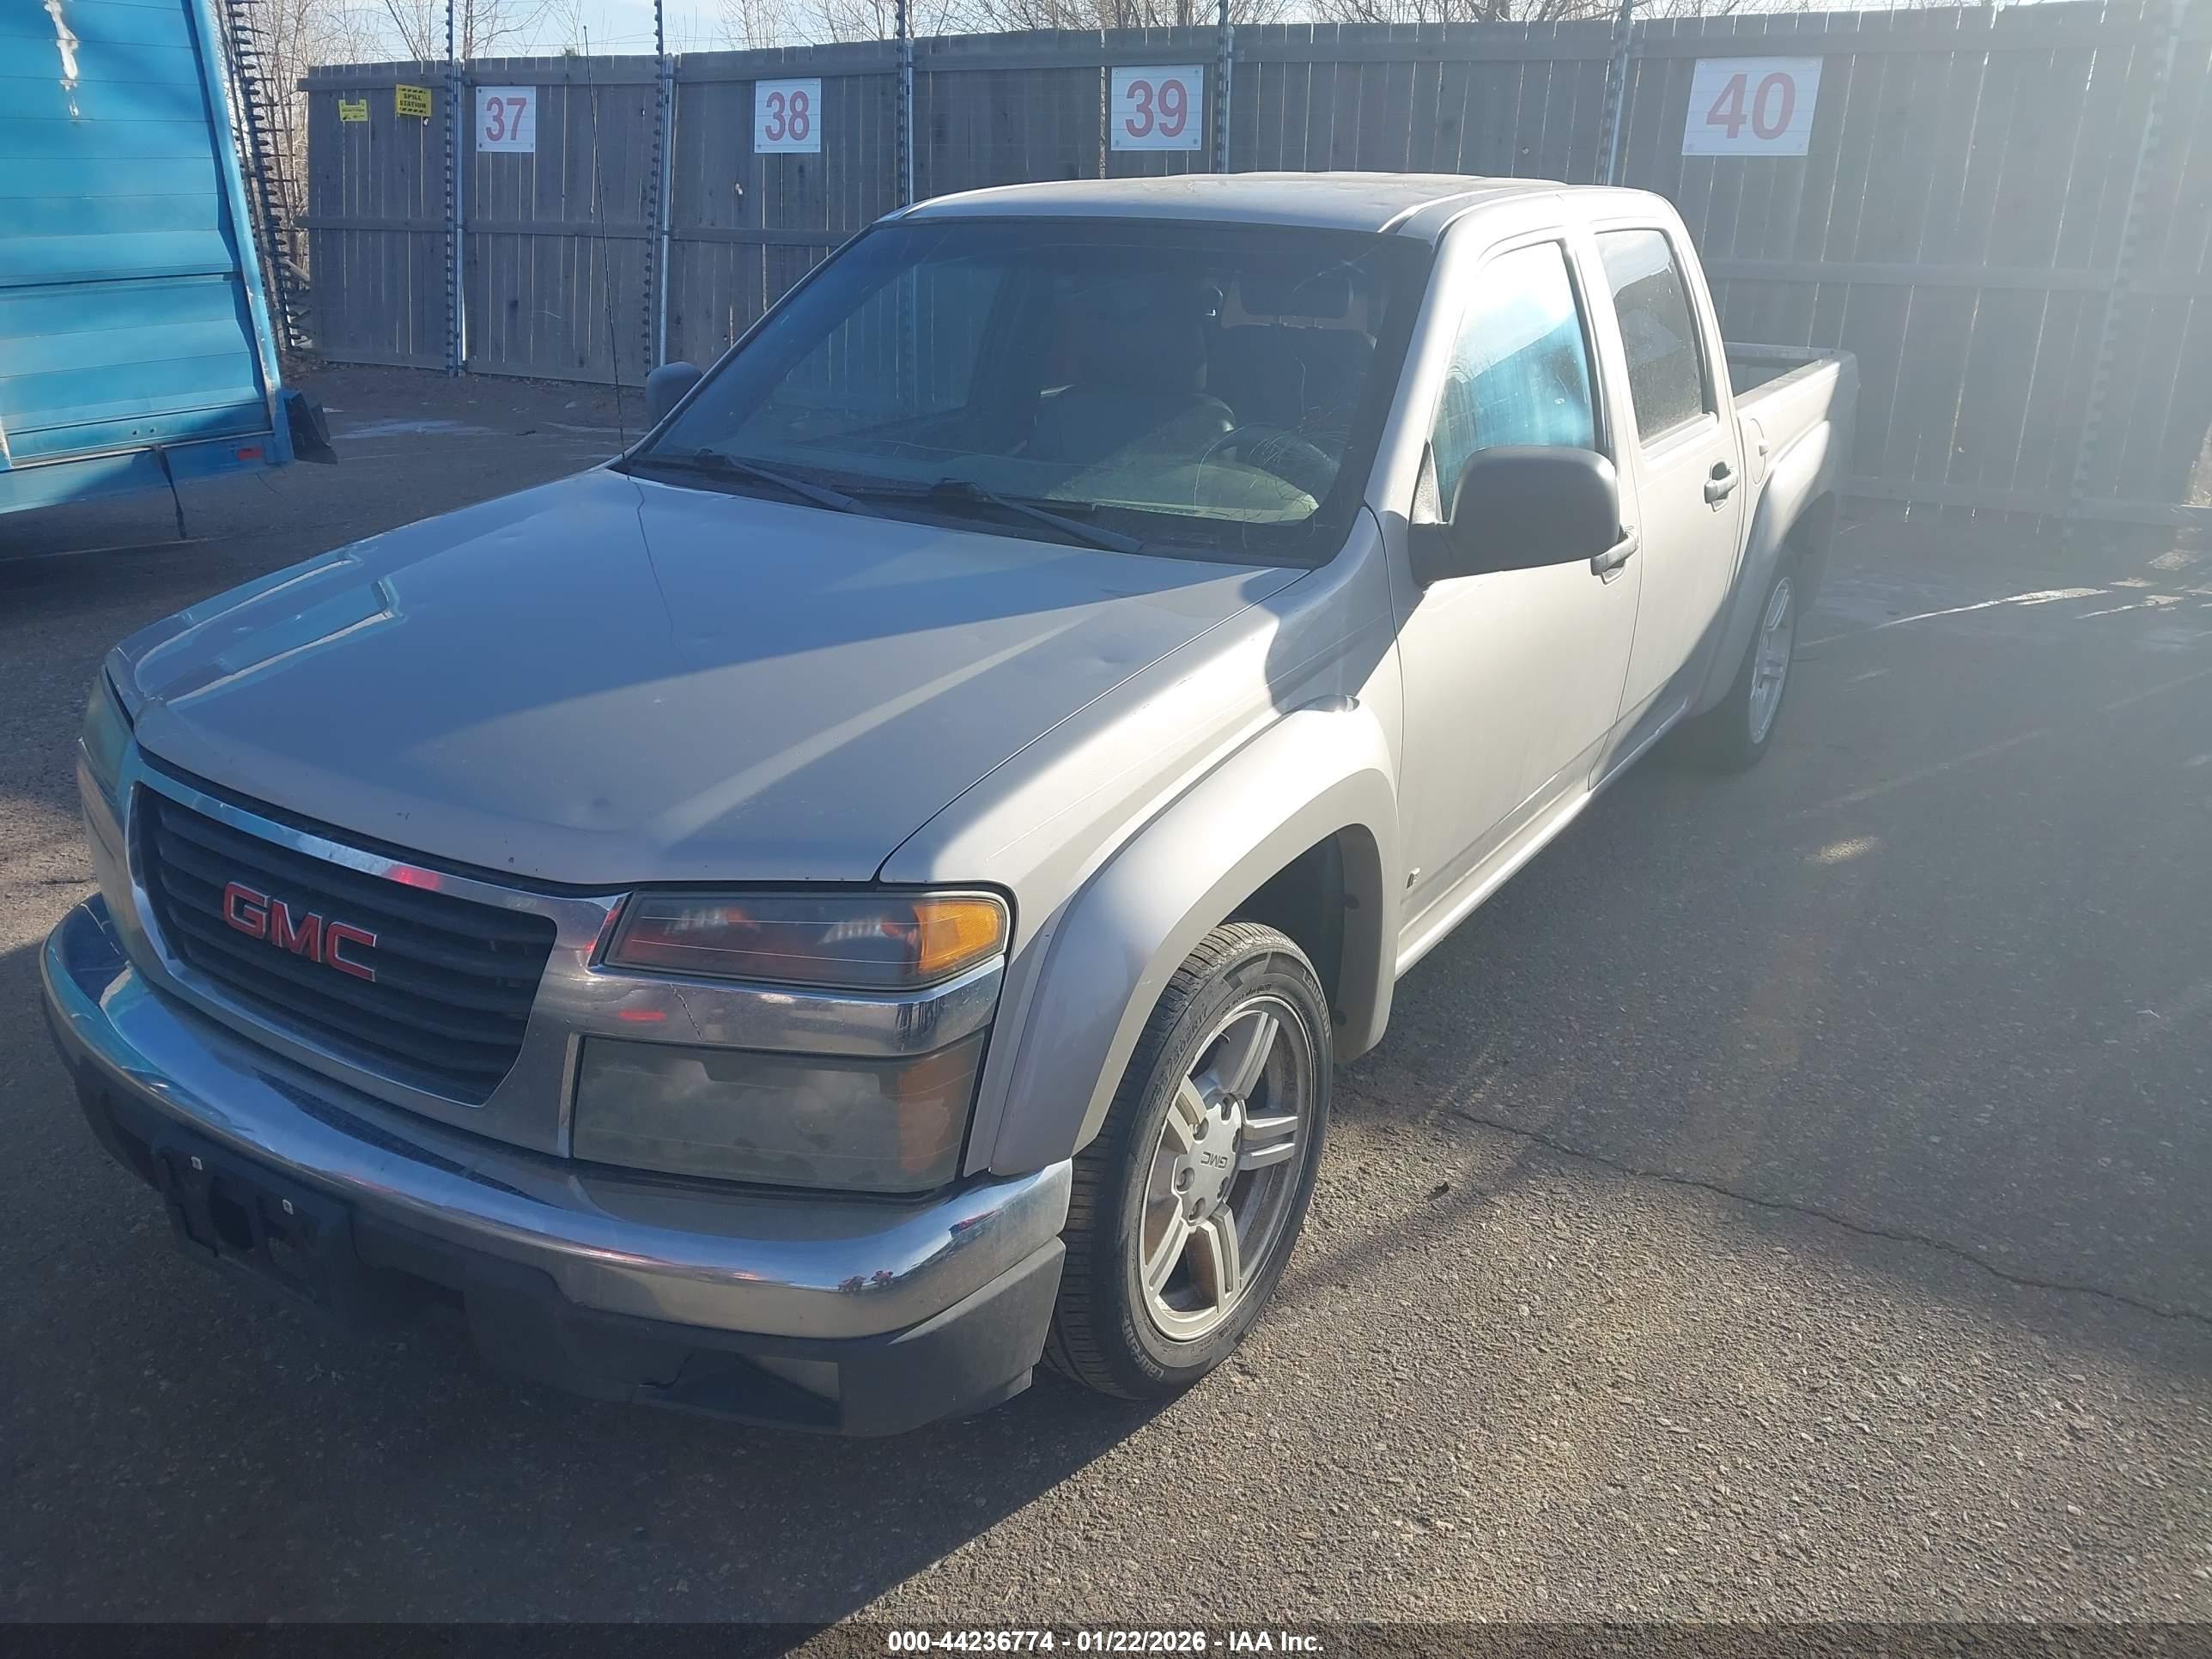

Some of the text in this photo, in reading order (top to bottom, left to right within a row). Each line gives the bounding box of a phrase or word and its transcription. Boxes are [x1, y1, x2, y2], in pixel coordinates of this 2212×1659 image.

[399, 100, 427, 109] STATION
[404, 93, 422, 101] SPILL
[486, 96, 527, 142] 37
[765, 90, 810, 142] 38
[1126, 79, 1188, 138] 39
[1706, 72, 1796, 140] 40
[223, 881, 378, 983] GMC
[1200, 1151, 1228, 1169] GMC
